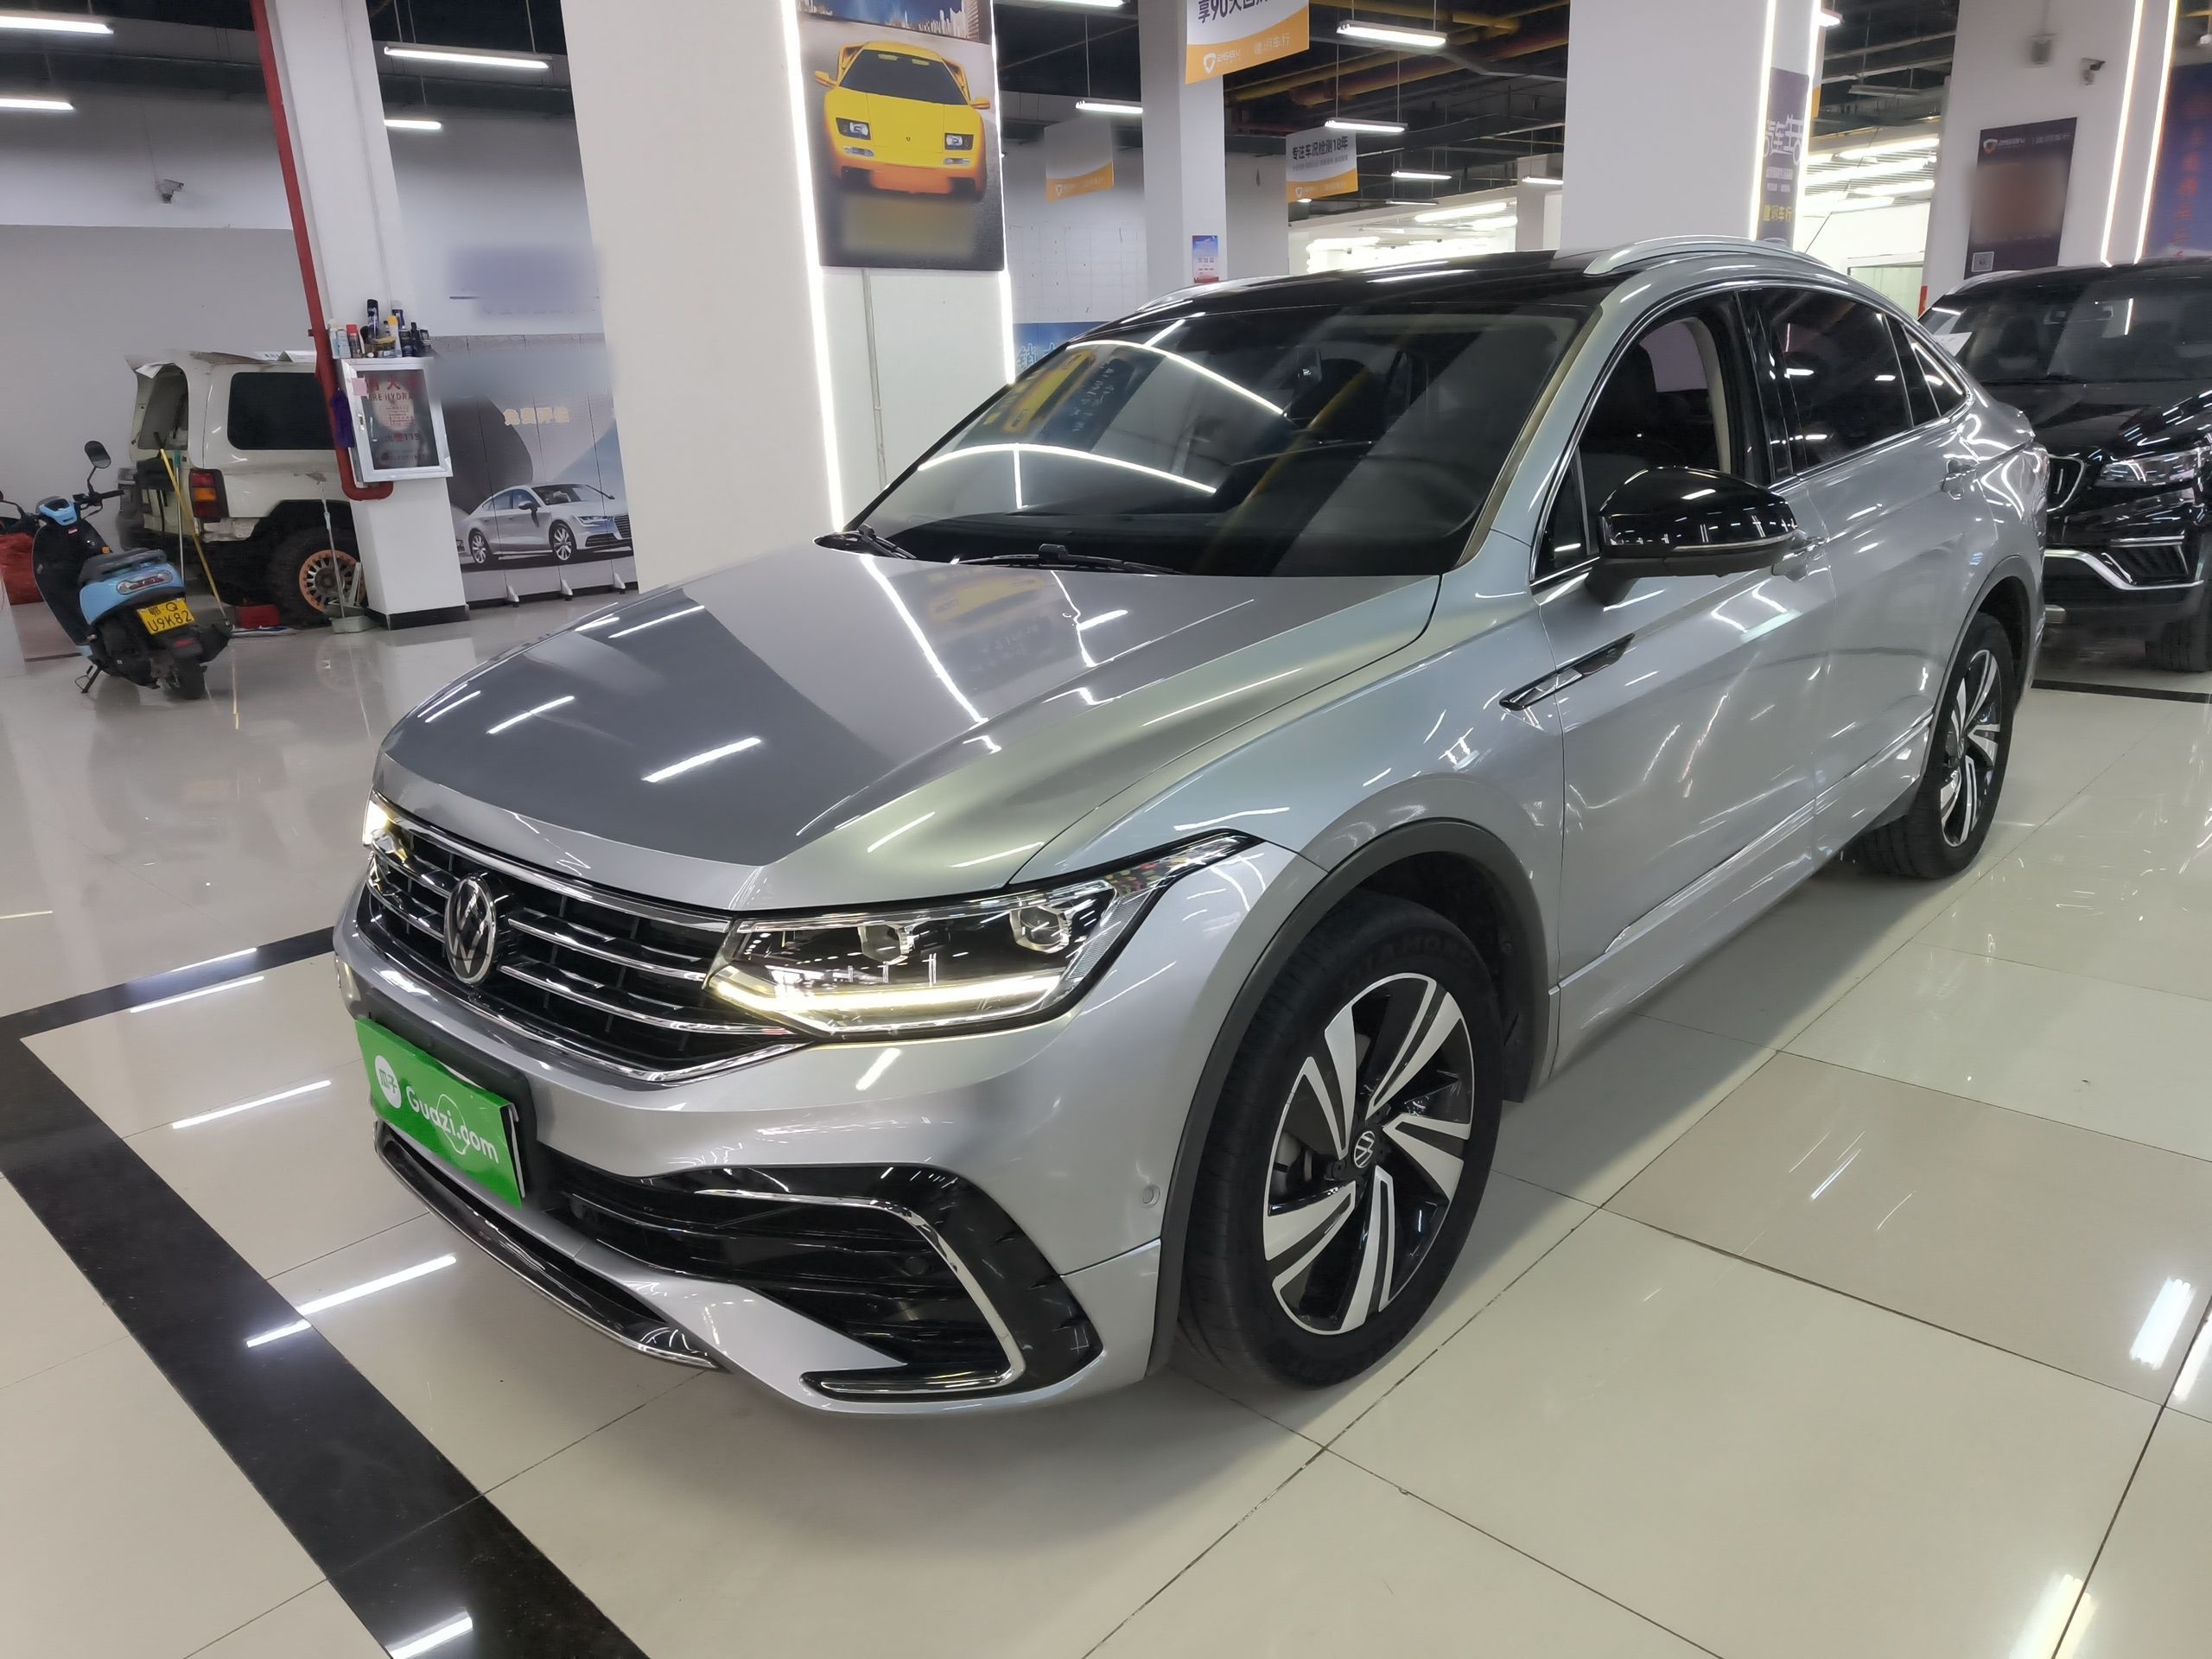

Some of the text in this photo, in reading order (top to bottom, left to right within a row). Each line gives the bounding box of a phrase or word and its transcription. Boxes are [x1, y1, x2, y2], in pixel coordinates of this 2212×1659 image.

[1198, 0, 1268, 23] 享90天
[147, 610, 193, 632] U9K82
[378, 1068, 398, 1094] 瓜子
[406, 1086, 499, 1164] Guazi.com
